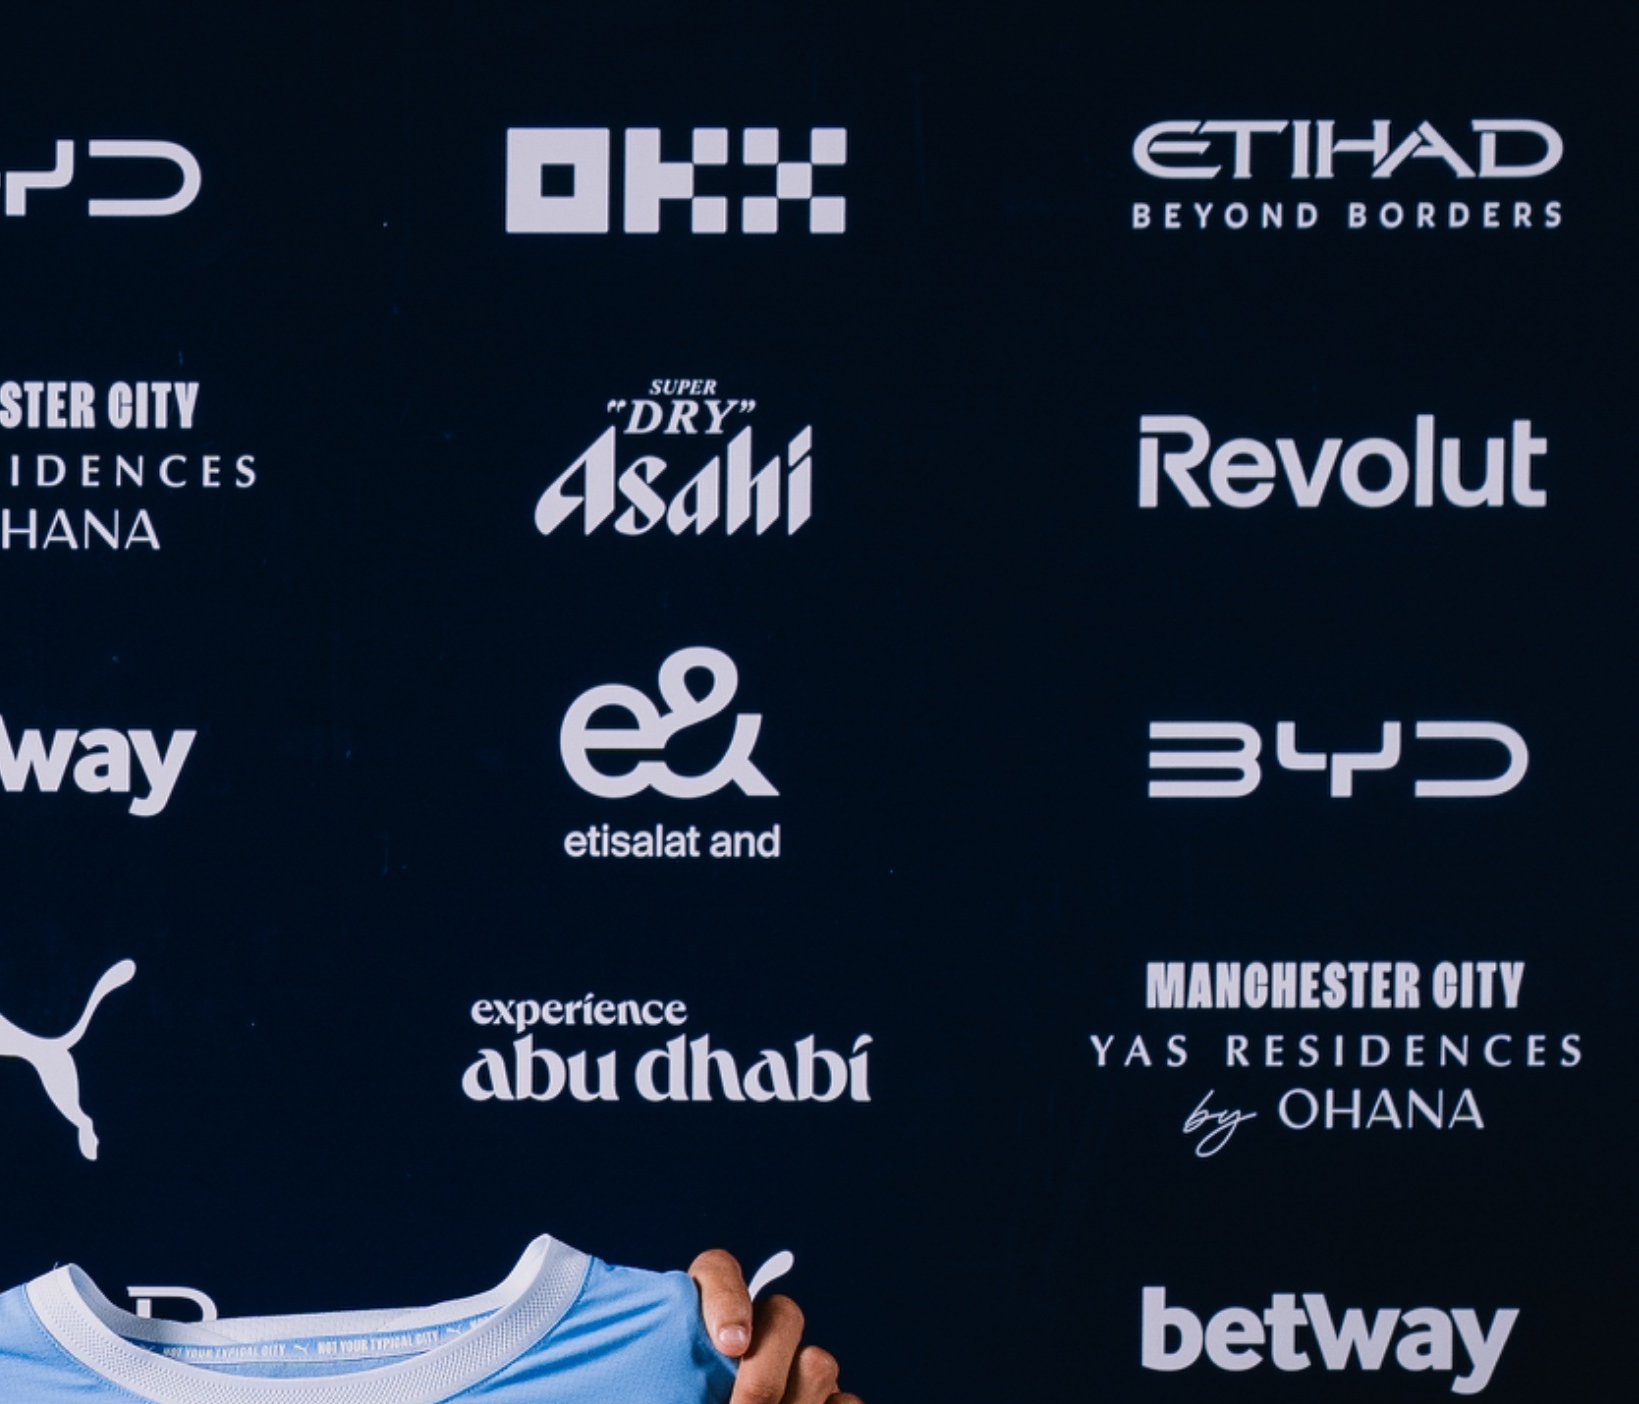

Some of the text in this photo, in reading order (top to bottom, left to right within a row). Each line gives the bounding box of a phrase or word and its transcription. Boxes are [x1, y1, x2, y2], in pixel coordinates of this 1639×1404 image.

[1131, 118, 1564, 180] ETIHAD
[504, 127, 848, 235] OKX
[1132, 200, 1562, 230] BEYOND BORDERS
[107, 380, 200, 430] CITY
[648, 378, 718, 396] SUPER
[533, 424, 813, 537] Asahi
[1138, 413, 1548, 509] Revolut
[1147, 720, 1530, 799] BYD
[563, 822, 781, 859] etisalat and
[1145, 960, 1526, 1010] MANCHESTER CITY
[461, 1032, 620, 1103] abu
[1089, 1033, 1582, 1068] YAS RESIDENCES
[1182, 1087, 1485, 1158] by OHANA
[186, 1346, 213, 1358] YOUR
[318, 1330, 439, 1354] NOT YOUR TYPICAL CITY
[1141, 1285, 1520, 1395] betway
